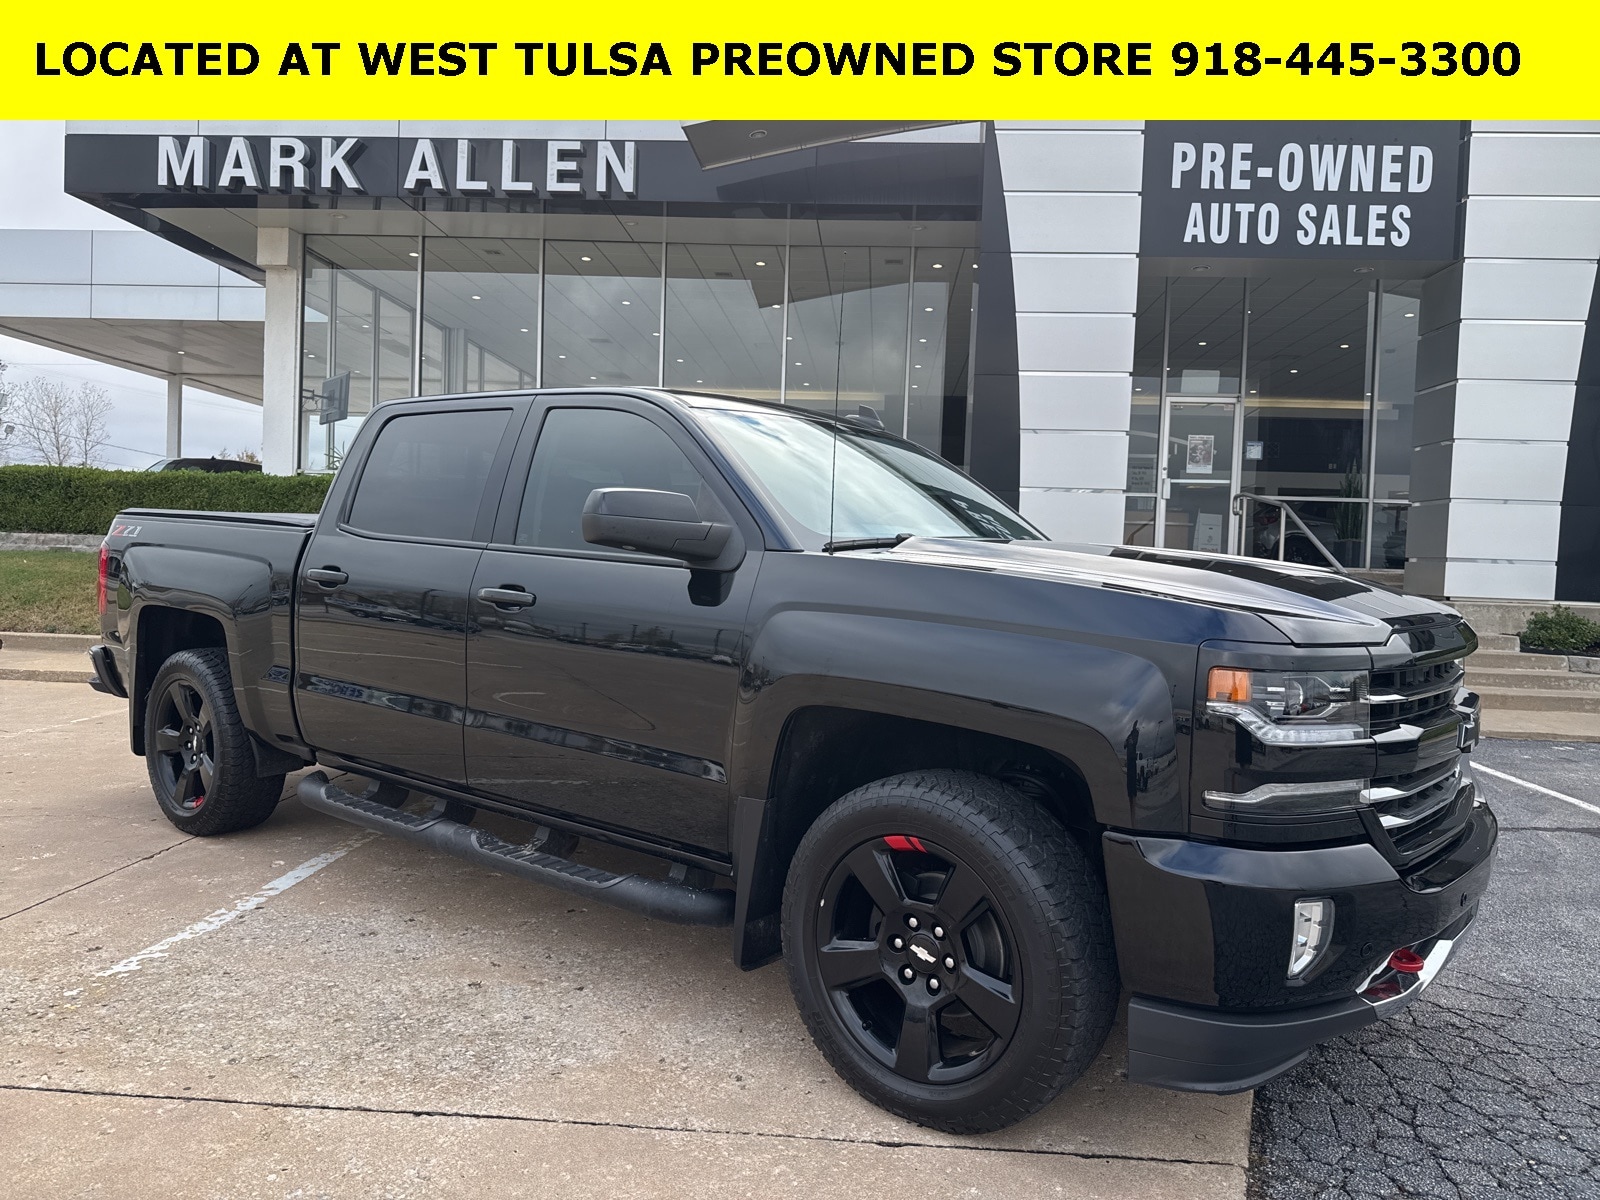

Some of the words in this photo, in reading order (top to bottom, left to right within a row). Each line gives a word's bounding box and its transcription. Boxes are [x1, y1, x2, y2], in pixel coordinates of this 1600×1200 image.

[157, 136, 363, 191] MARK
[403, 138, 637, 194] ALLEN
[1171, 142, 1434, 193] PRE-OWNED
[1183, 202, 1280, 245] AUTO
[1296, 203, 1412, 247] SALES
[111, 524, 143, 538] Z71
